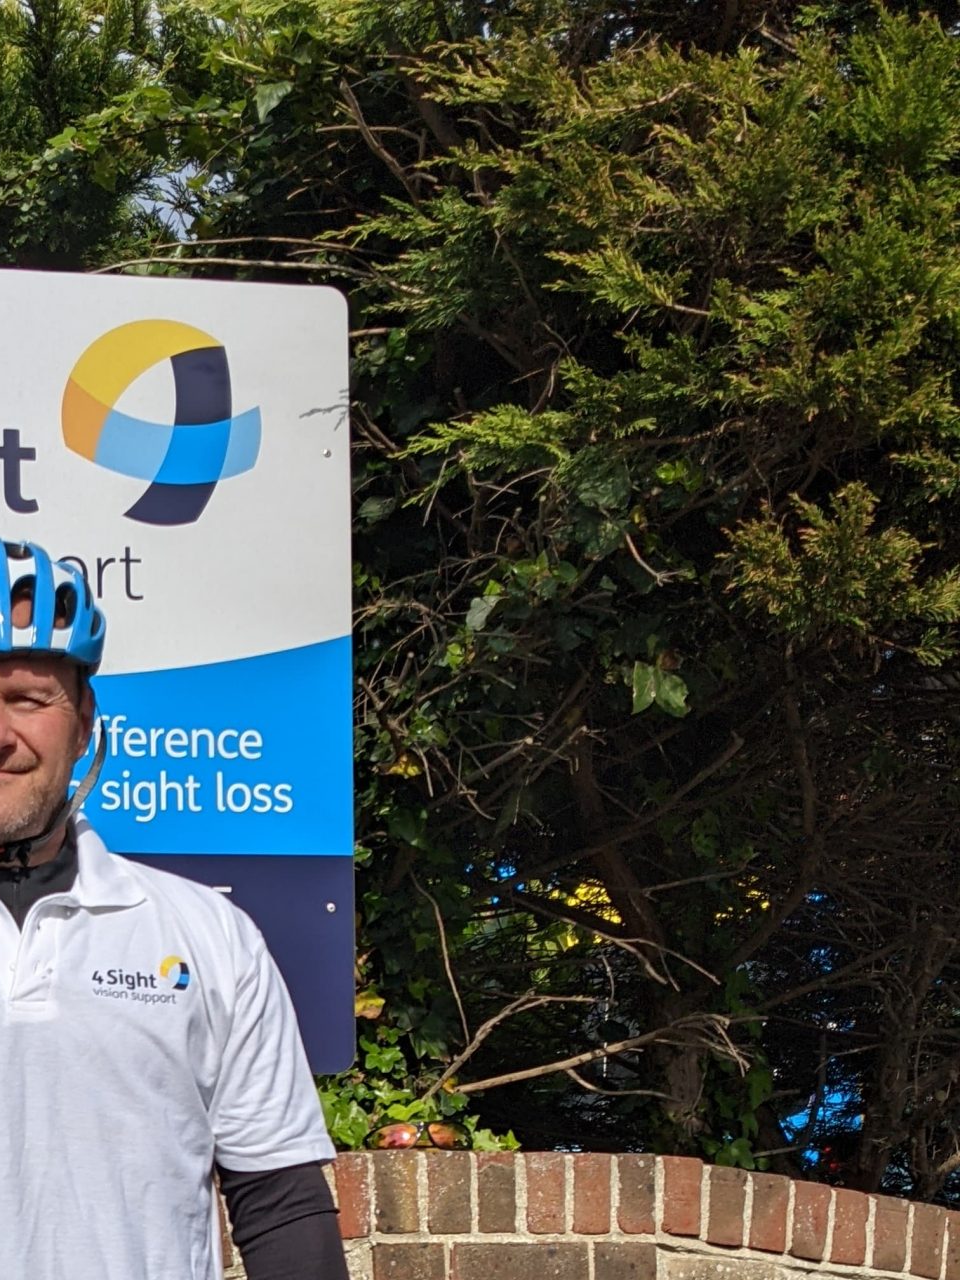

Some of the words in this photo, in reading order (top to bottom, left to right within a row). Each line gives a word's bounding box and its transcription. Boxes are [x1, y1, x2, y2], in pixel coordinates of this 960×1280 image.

[85, 714, 264, 760] fference
[101, 770, 202, 822] sight
[216, 771, 294, 813] loss
[92, 970, 104, 986] 4
[106, 969, 158, 990] Sight
[93, 988, 128, 1000] vision
[131, 991, 177, 1005] support
